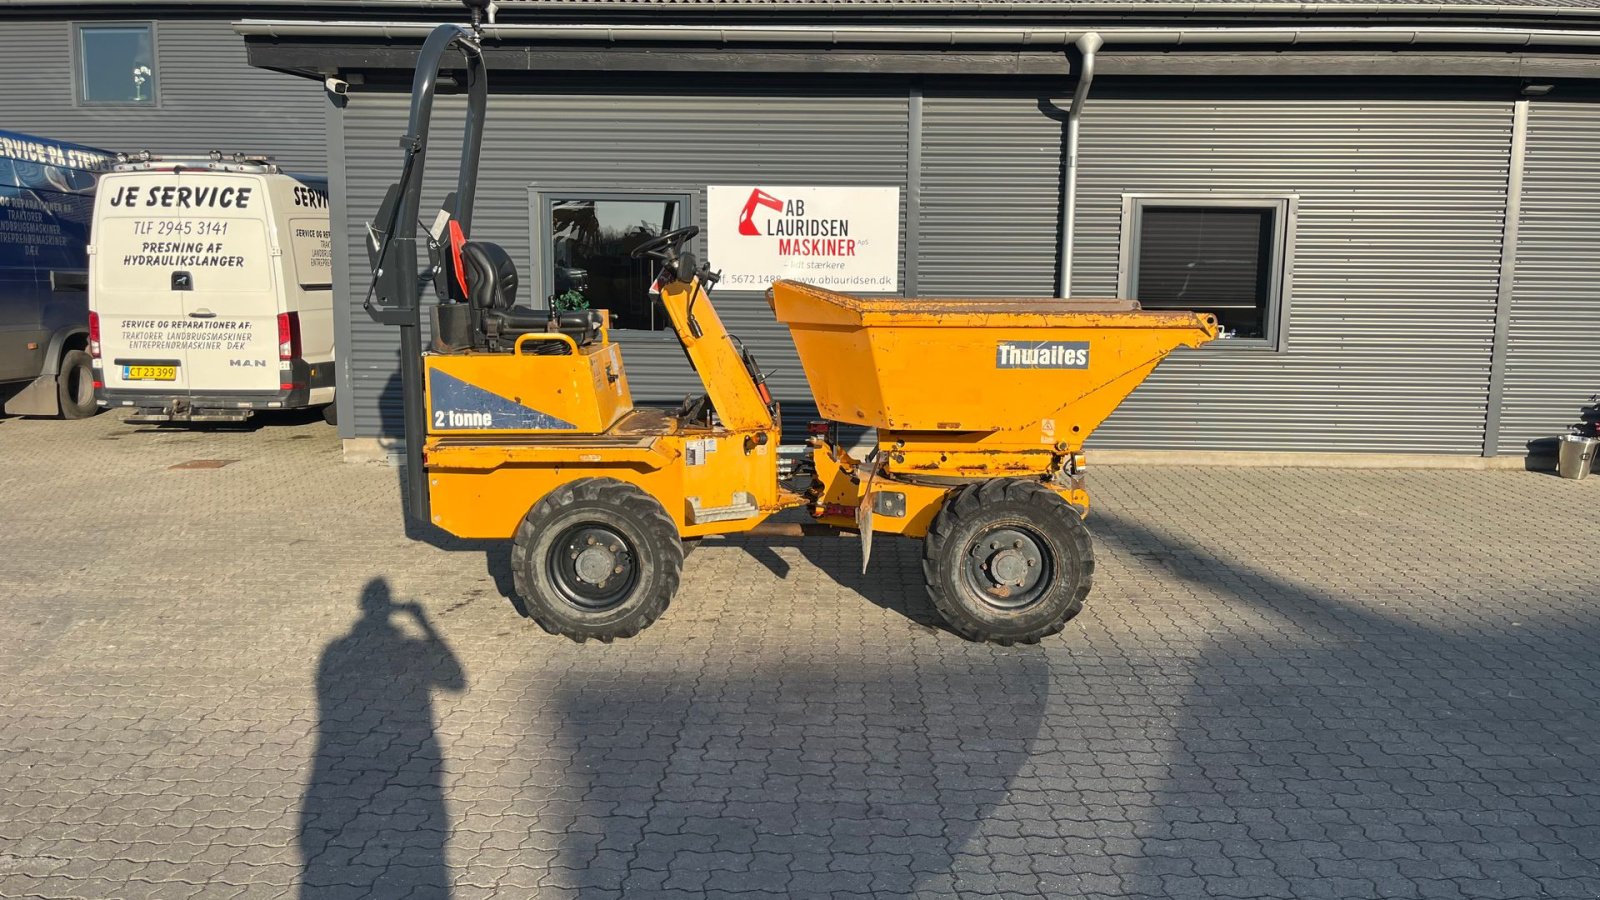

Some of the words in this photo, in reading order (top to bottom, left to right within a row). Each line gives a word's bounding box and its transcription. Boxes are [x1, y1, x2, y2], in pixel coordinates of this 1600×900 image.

[110, 186, 140, 208] JE
[146, 186, 252, 209] SERVICE
[785, 199, 805, 217] AB
[134, 221, 153, 234] TLF
[158, 221, 192, 235] 2945
[197, 222, 227, 235] 3141
[767, 219, 849, 237] LAURIDSEN
[142, 242, 202, 254] PRESNING
[207, 242, 222, 254] AF
[779, 238, 856, 256] MASKINER
[123, 256, 244, 268] HYDRAULIKSLANGER
[806, 261, 846, 270] stærkere
[731, 275, 755, 284] 5672
[758, 274, 782, 284] 1488
[121, 320, 155, 329] SERVICE
[157, 321, 169, 329] OG
[171, 321, 236, 330] REPARATIONER
[238, 322, 252, 330] AF:
[122, 331, 163, 340] TRAKTORER
[167, 332, 252, 342] LANDBRUGSMASKINER
[129, 340, 221, 350] ENTREPRENØRMASKINER
[227, 341, 245, 350] DÆK
[999, 344, 1087, 366] Thwaites
[229, 359, 266, 368] MAN
[130, 367, 142, 377] CT
[144, 367, 155, 377] 23
[156, 367, 174, 377] 399
[435, 410, 445, 427] 2
[449, 410, 493, 428] tonne
